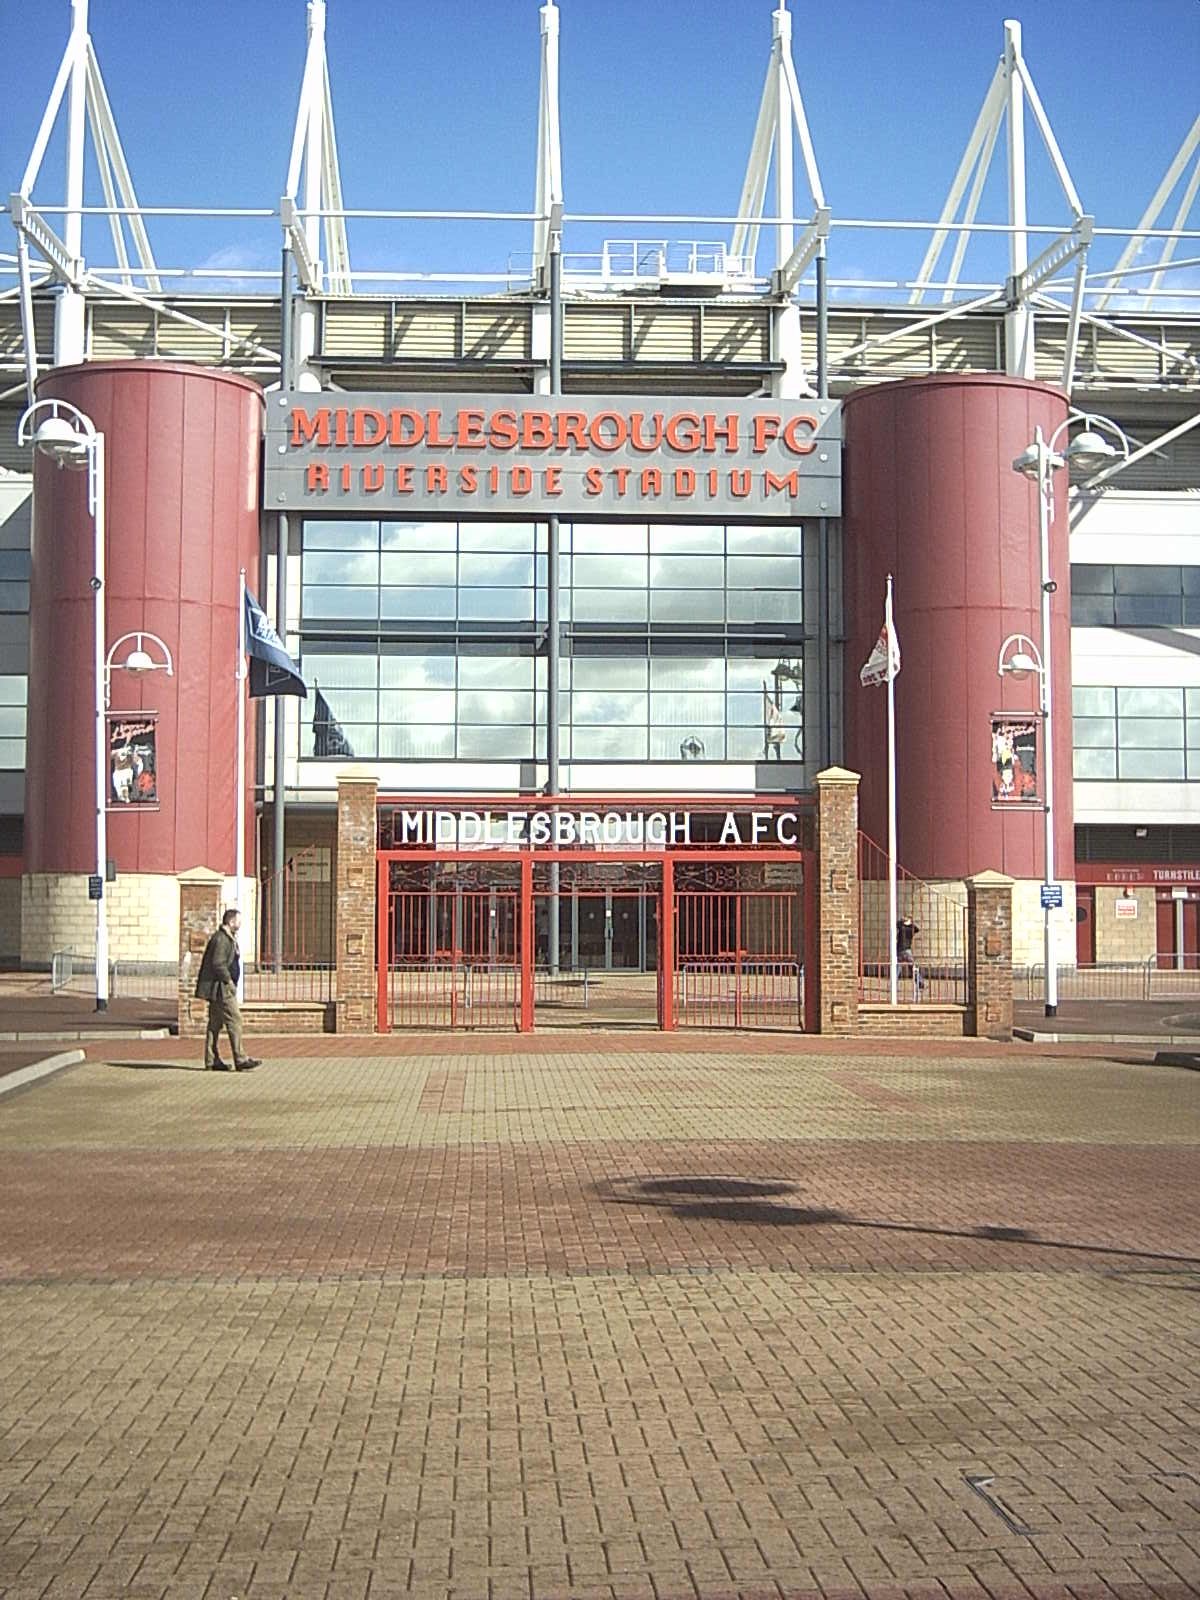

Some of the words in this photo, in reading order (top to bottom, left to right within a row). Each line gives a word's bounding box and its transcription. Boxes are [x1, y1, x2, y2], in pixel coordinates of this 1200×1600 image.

[290, 407, 739, 453] MIDDLESBROUGH
[753, 412, 819, 454] FC
[306, 462, 563, 495] RIVERSIDE
[586, 466, 799, 498] STADIUM
[401, 810, 691, 845] MIDDLESBROUGH
